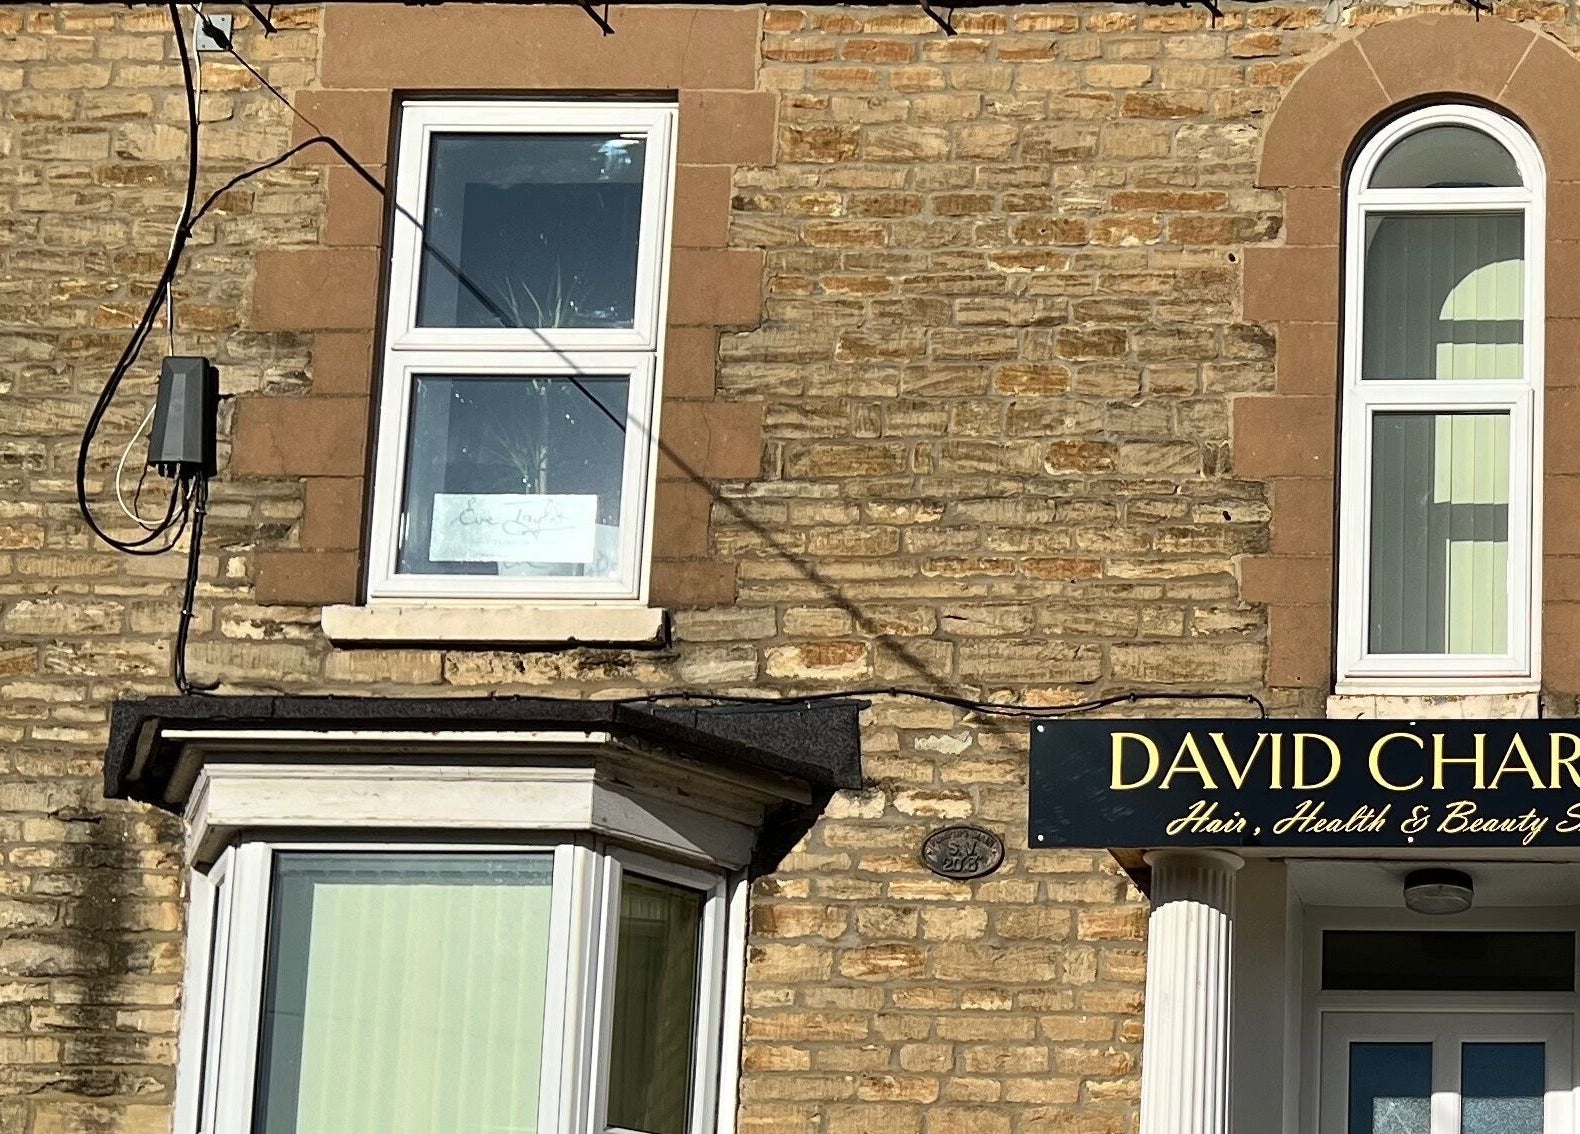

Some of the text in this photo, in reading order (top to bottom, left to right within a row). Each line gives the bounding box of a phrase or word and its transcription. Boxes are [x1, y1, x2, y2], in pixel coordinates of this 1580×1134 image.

[1110, 732, 1342, 791] DAVID
[1273, 800, 1393, 836] Health
[1400, 805, 1432, 834] &
[1437, 800, 1549, 846] Beauty
